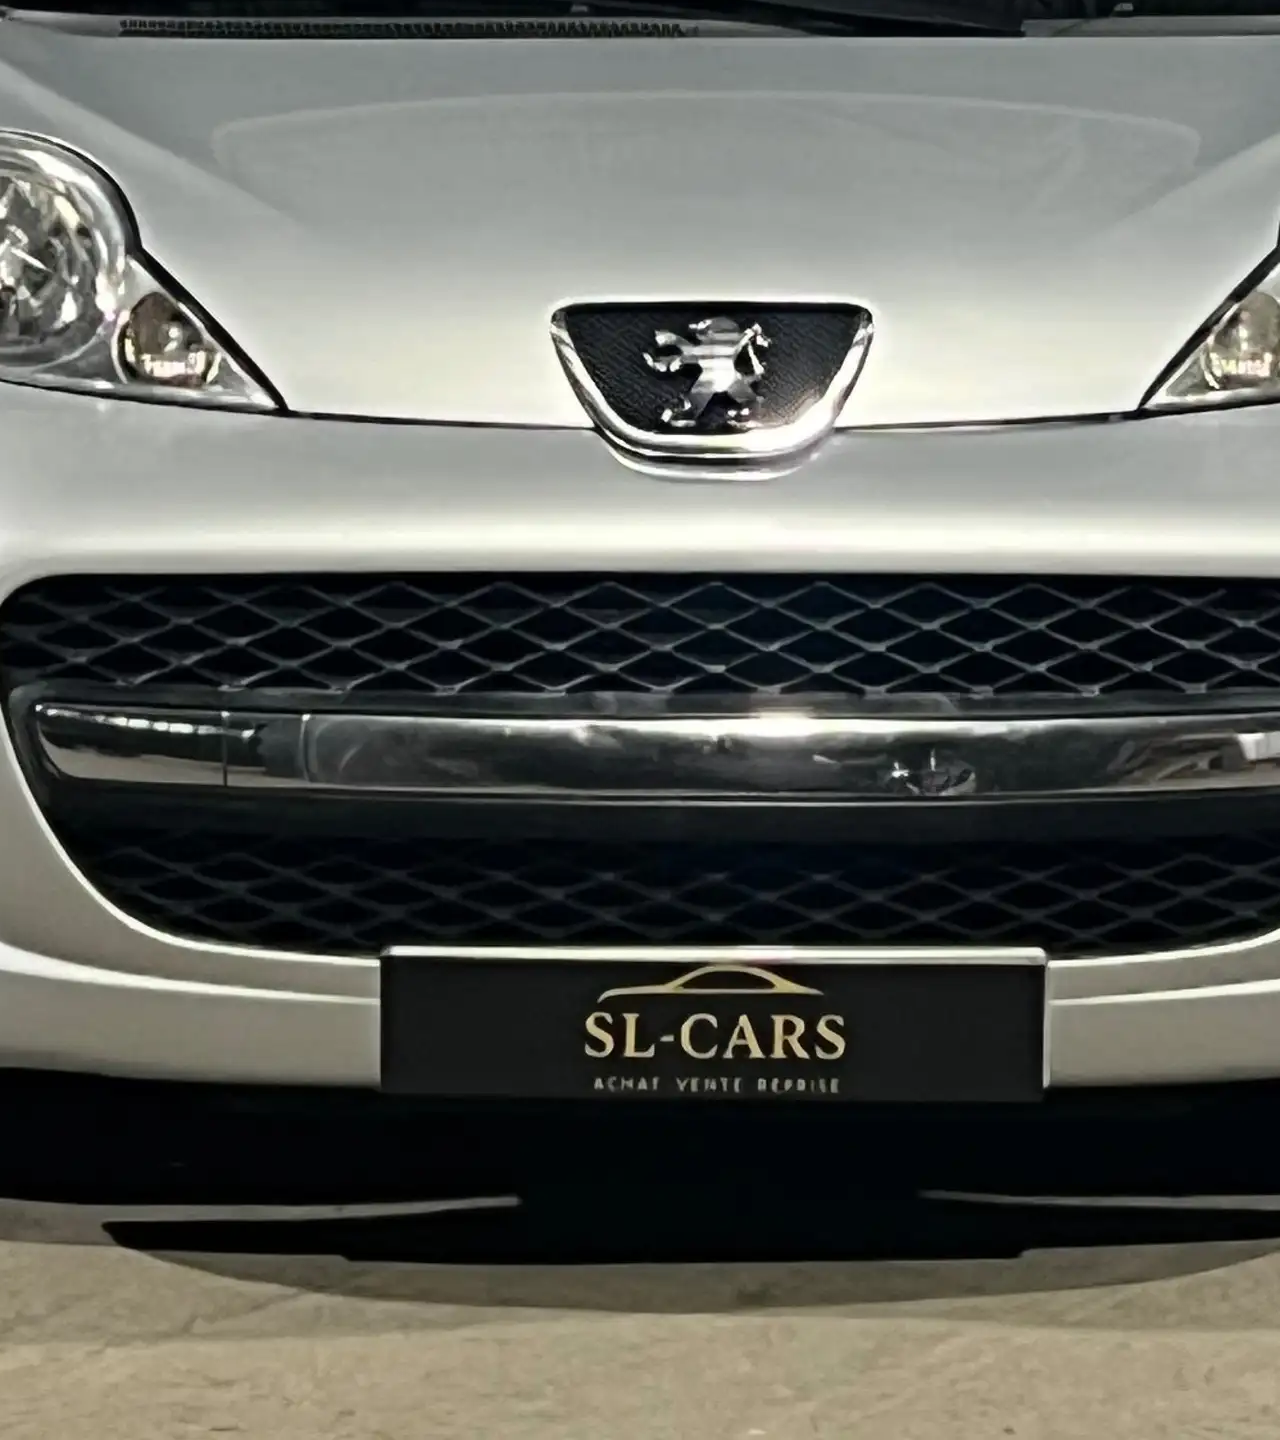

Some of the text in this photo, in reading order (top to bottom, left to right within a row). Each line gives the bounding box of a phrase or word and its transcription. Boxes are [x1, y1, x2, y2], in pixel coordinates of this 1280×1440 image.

[583, 1011, 847, 1060] SL-CARS
[592, 1075, 840, 1095] ACHAT VENTE REPRISE
